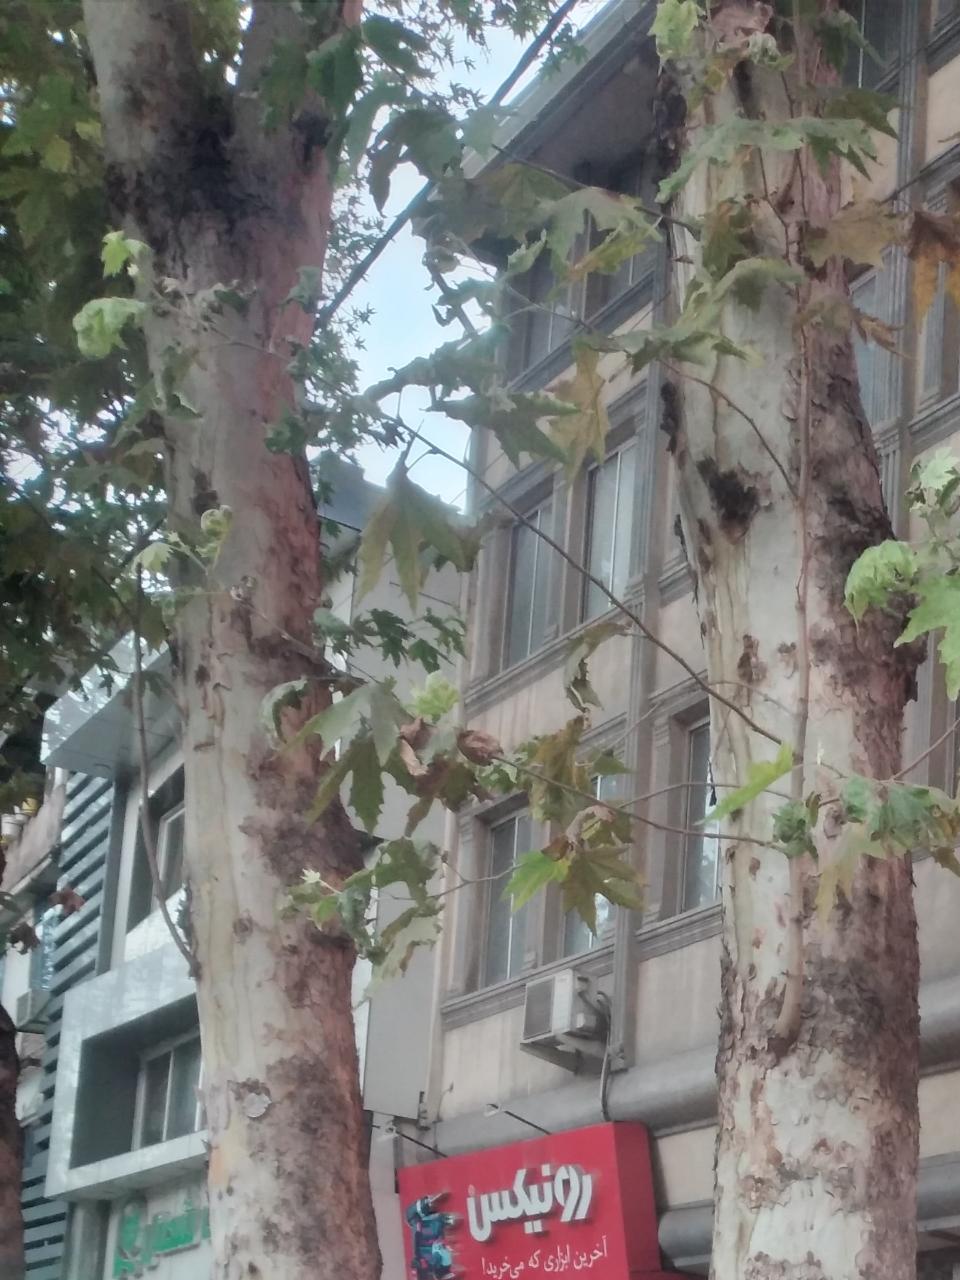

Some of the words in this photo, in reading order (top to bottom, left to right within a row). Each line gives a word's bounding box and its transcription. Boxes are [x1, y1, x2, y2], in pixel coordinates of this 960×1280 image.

[466, 1163, 593, 1242] رونیکس
[528, 1249, 541, 1269] که
[543, 1244, 571, 1272] ابزاری
[573, 1235, 608, 1269] آخرین
